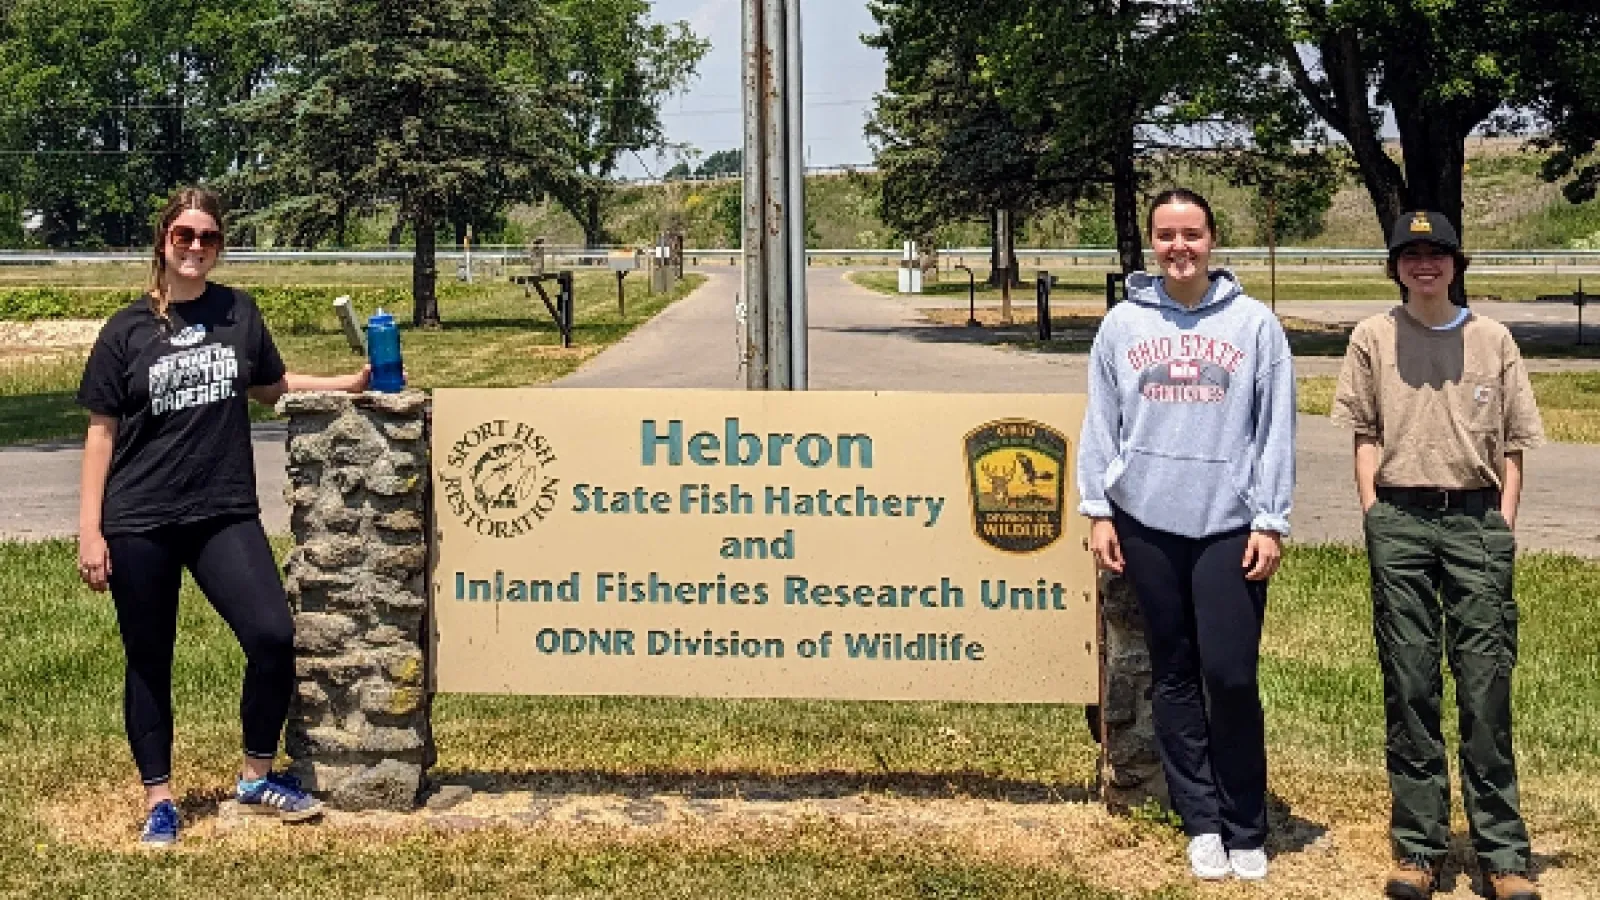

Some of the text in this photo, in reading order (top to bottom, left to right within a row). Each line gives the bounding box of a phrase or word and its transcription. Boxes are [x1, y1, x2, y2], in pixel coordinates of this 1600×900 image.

[1127, 335, 1172, 371] OHIO
[1180, 333, 1247, 373] STATE
[447, 419, 558, 469] SPORT FISH
[640, 417, 874, 469] Hebron
[438, 475, 561, 539] RESTORATION
[572, 483, 946, 528] State Fish Hatchery
[719, 530, 795, 560] and
[983, 523, 1055, 537] WILDLIFE
[454, 570, 1067, 611] Inland Fisheries Research Unit
[535, 628, 986, 662] ODNR Division of Wildlife
